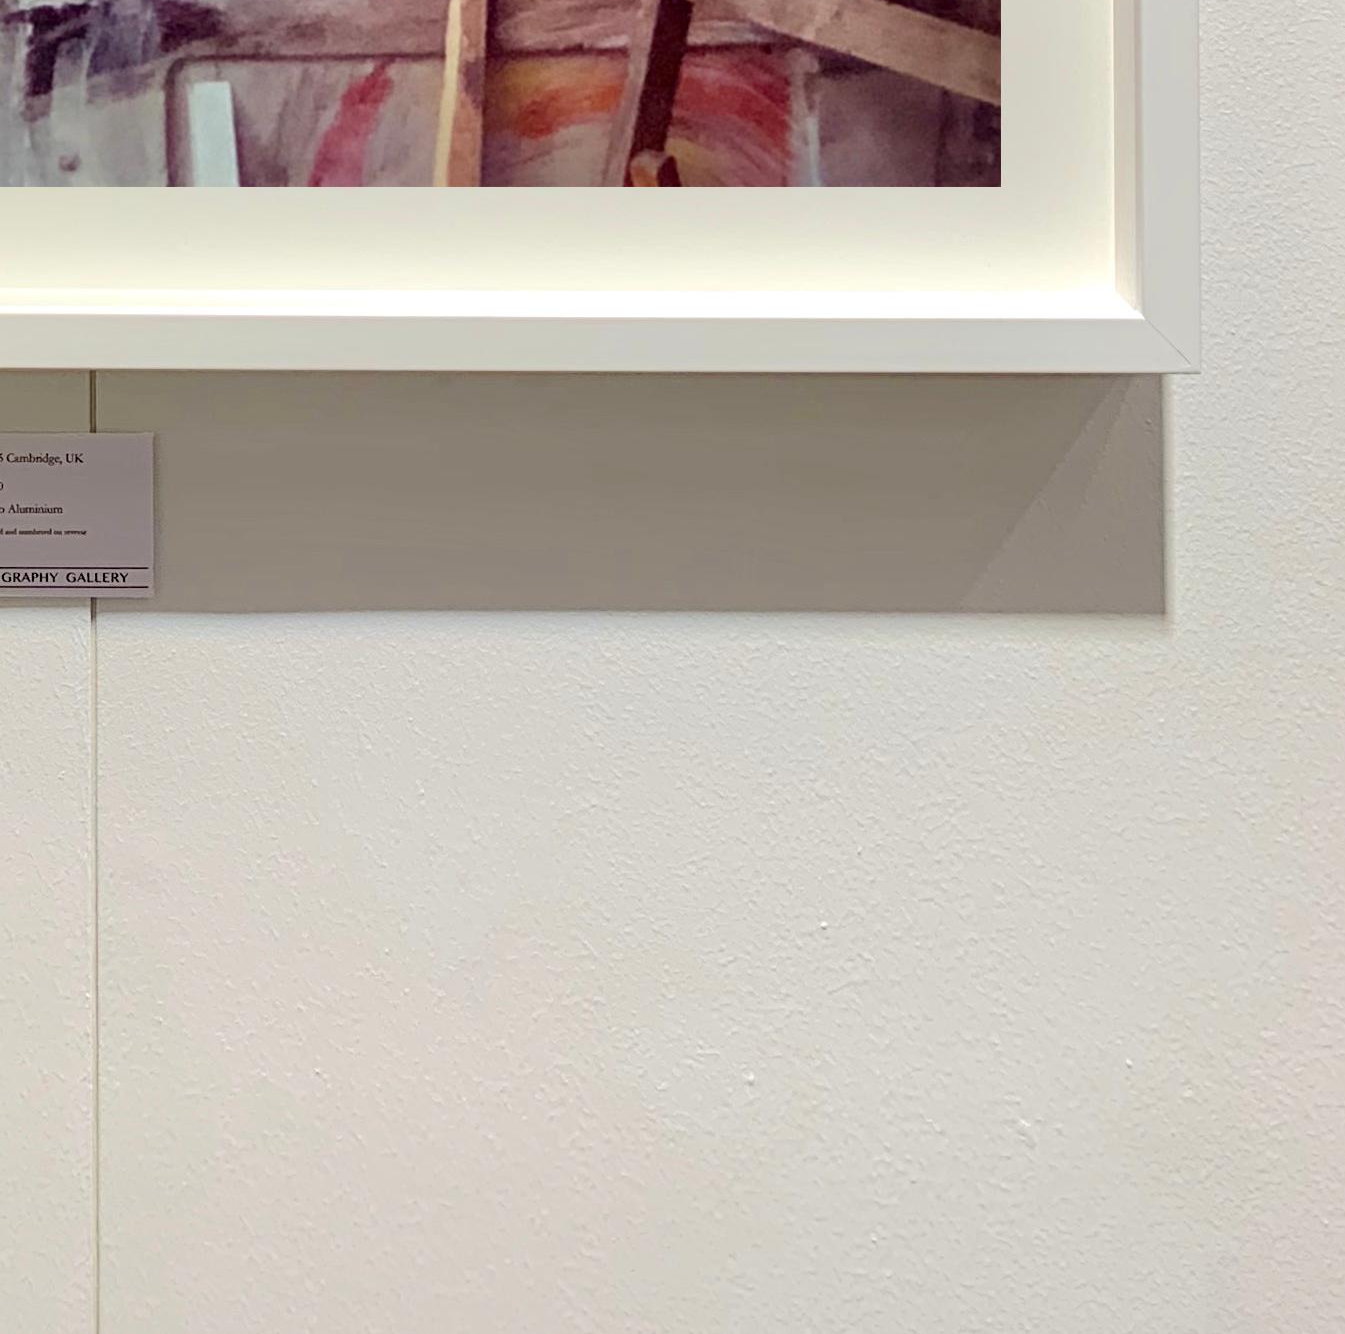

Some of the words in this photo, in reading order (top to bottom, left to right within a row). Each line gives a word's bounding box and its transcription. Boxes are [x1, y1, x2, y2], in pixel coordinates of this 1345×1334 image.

[6, 452, 63, 466] Cambridge,
[66, 453, 84, 463] UK
[8, 503, 63, 514] Aluminium
[65, 572, 129, 583] GALLERY
